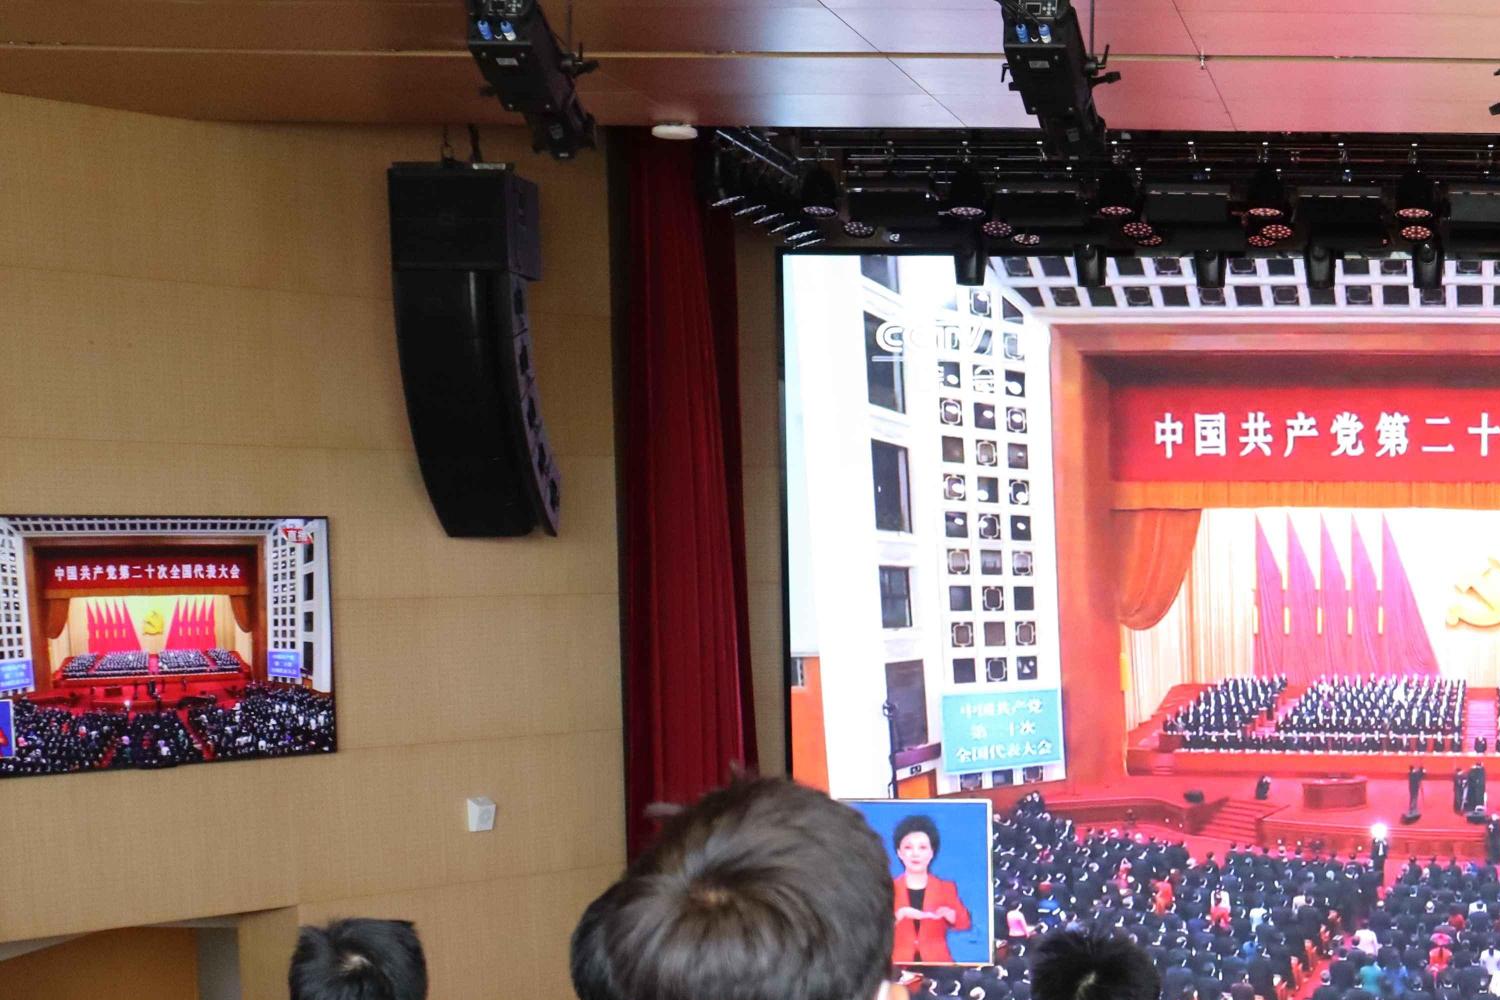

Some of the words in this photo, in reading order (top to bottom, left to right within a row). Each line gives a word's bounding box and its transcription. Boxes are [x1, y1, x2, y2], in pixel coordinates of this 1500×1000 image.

[54, 564, 241, 582] 中国共产党第二十次全国代表大会
